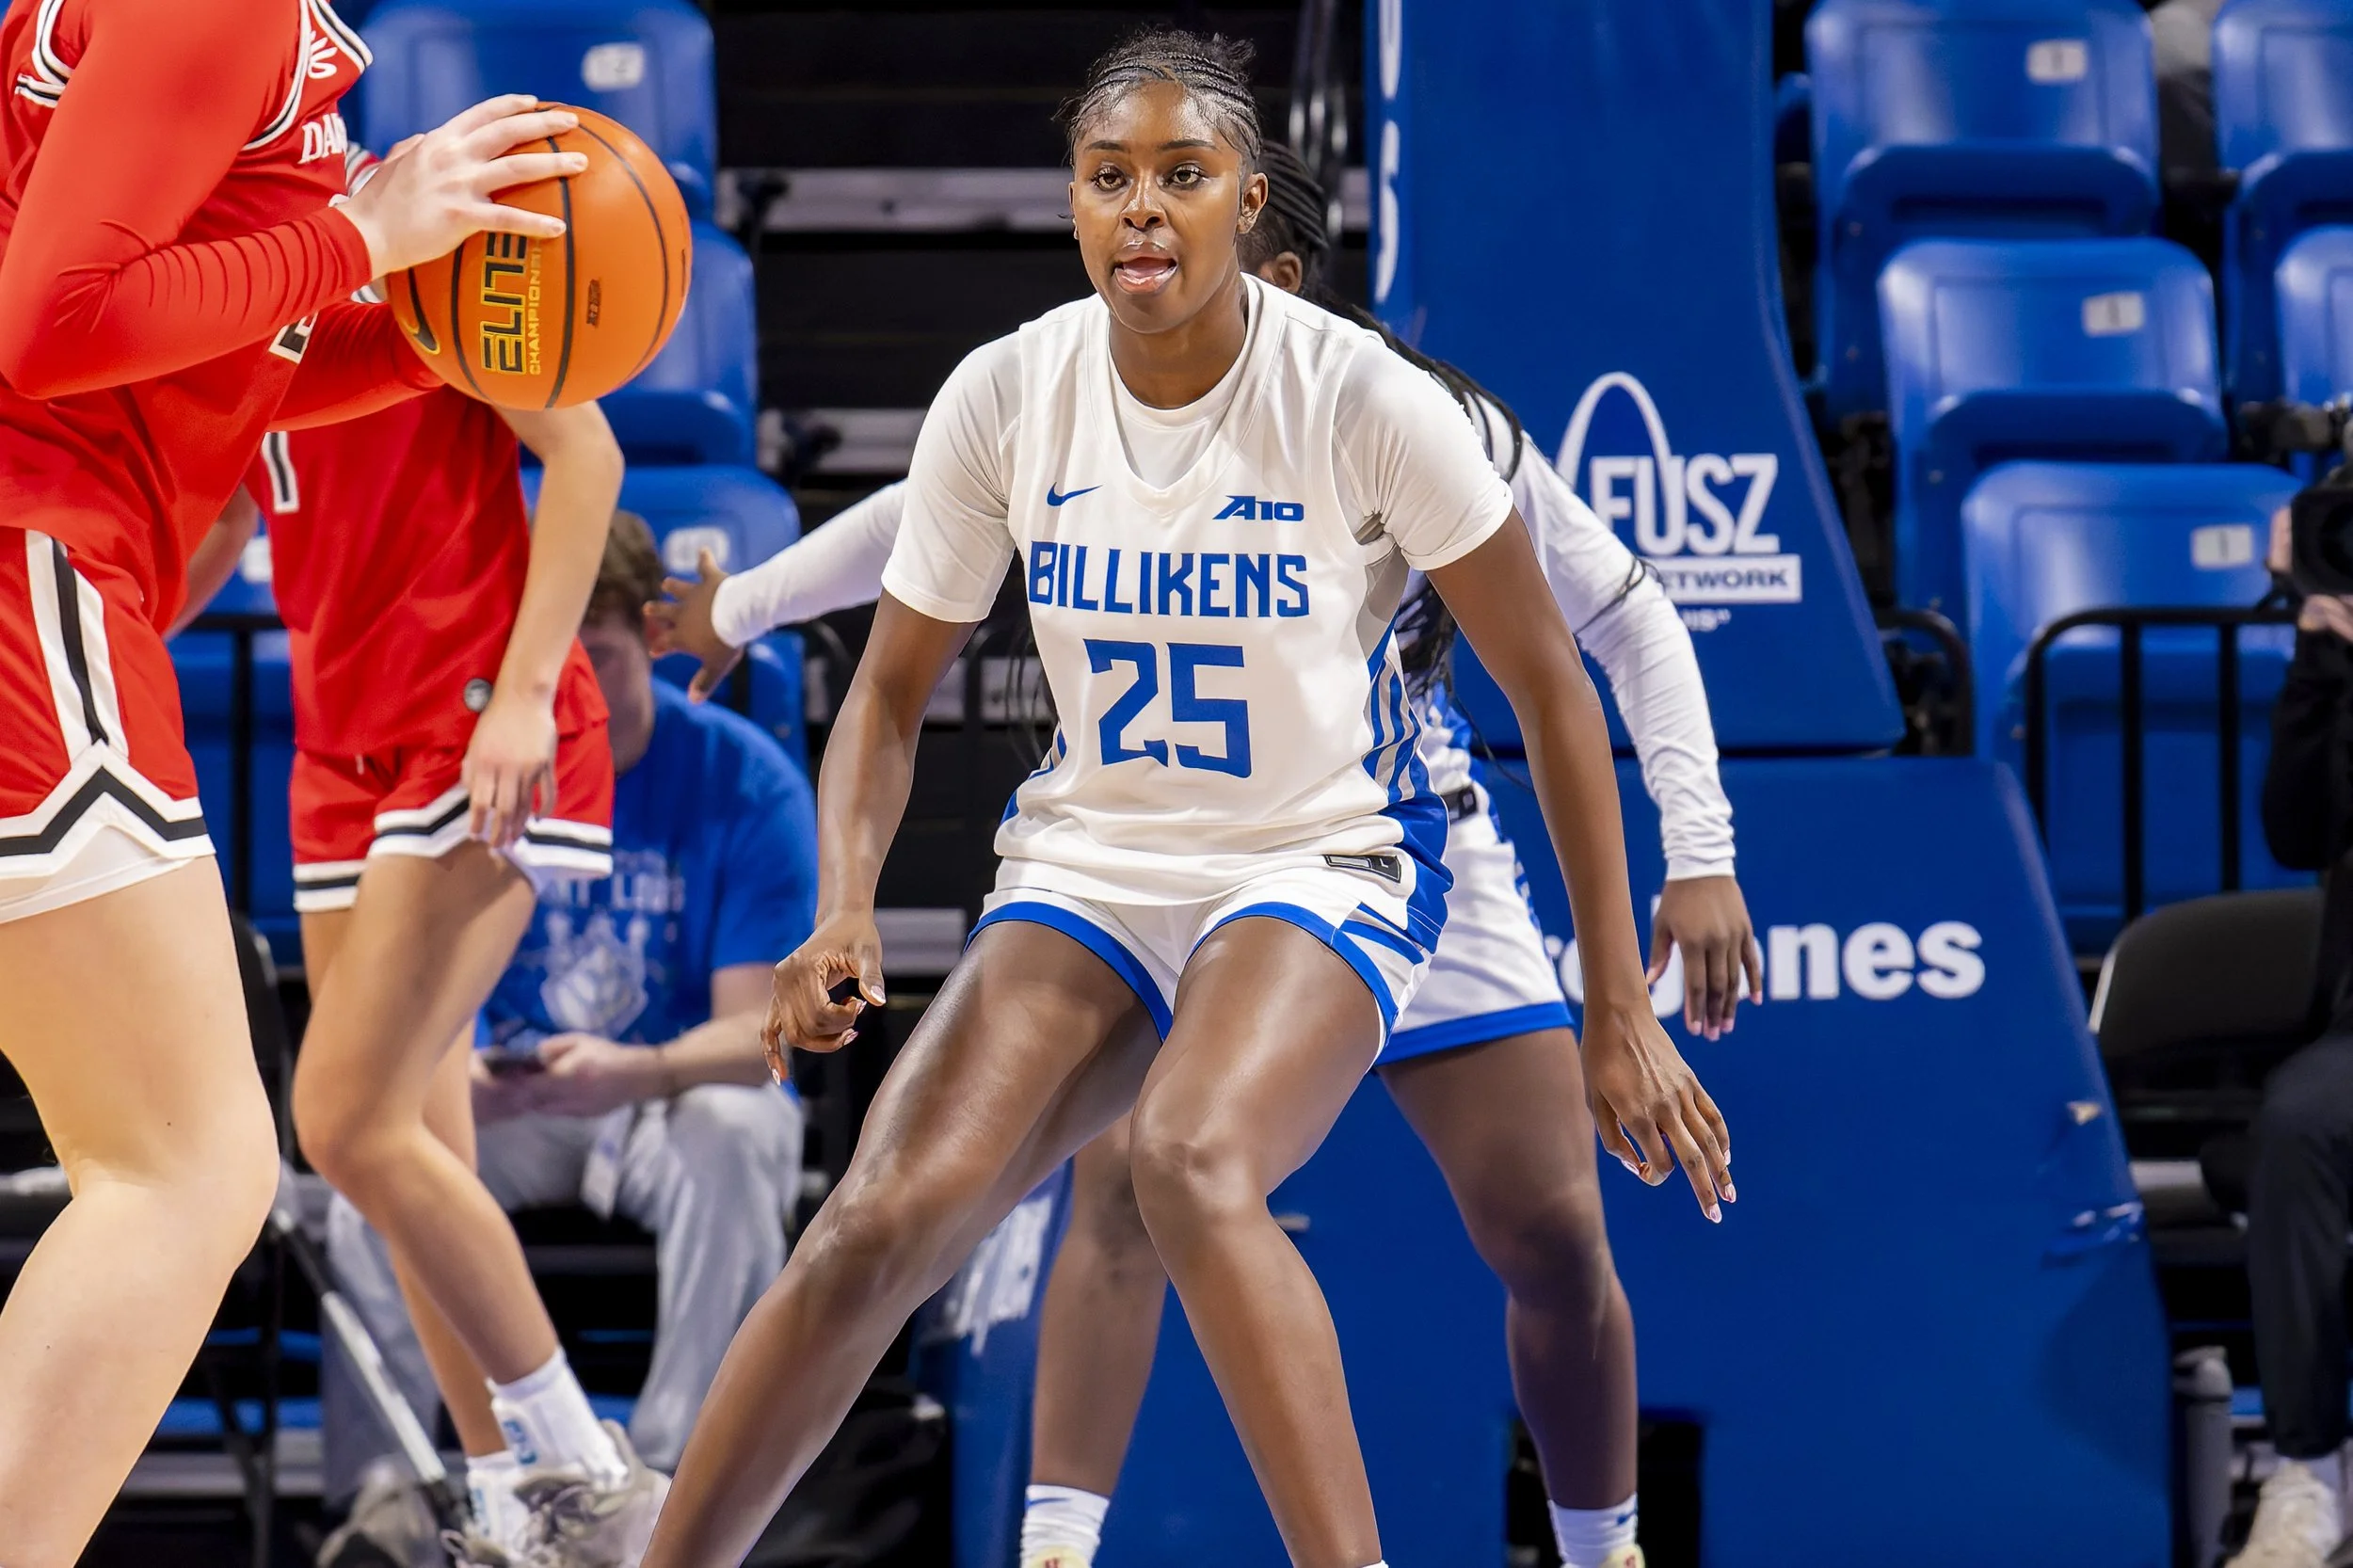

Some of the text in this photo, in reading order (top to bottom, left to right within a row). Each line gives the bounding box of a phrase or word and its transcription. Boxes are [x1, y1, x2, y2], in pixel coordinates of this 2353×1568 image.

[480, 231, 527, 375] ELITE
[1212, 495, 1305, 522] A10
[1590, 453, 1780, 555] FUSZ
[1029, 540, 1309, 617] BILLIKENS
[1082, 638, 1252, 778] 25
